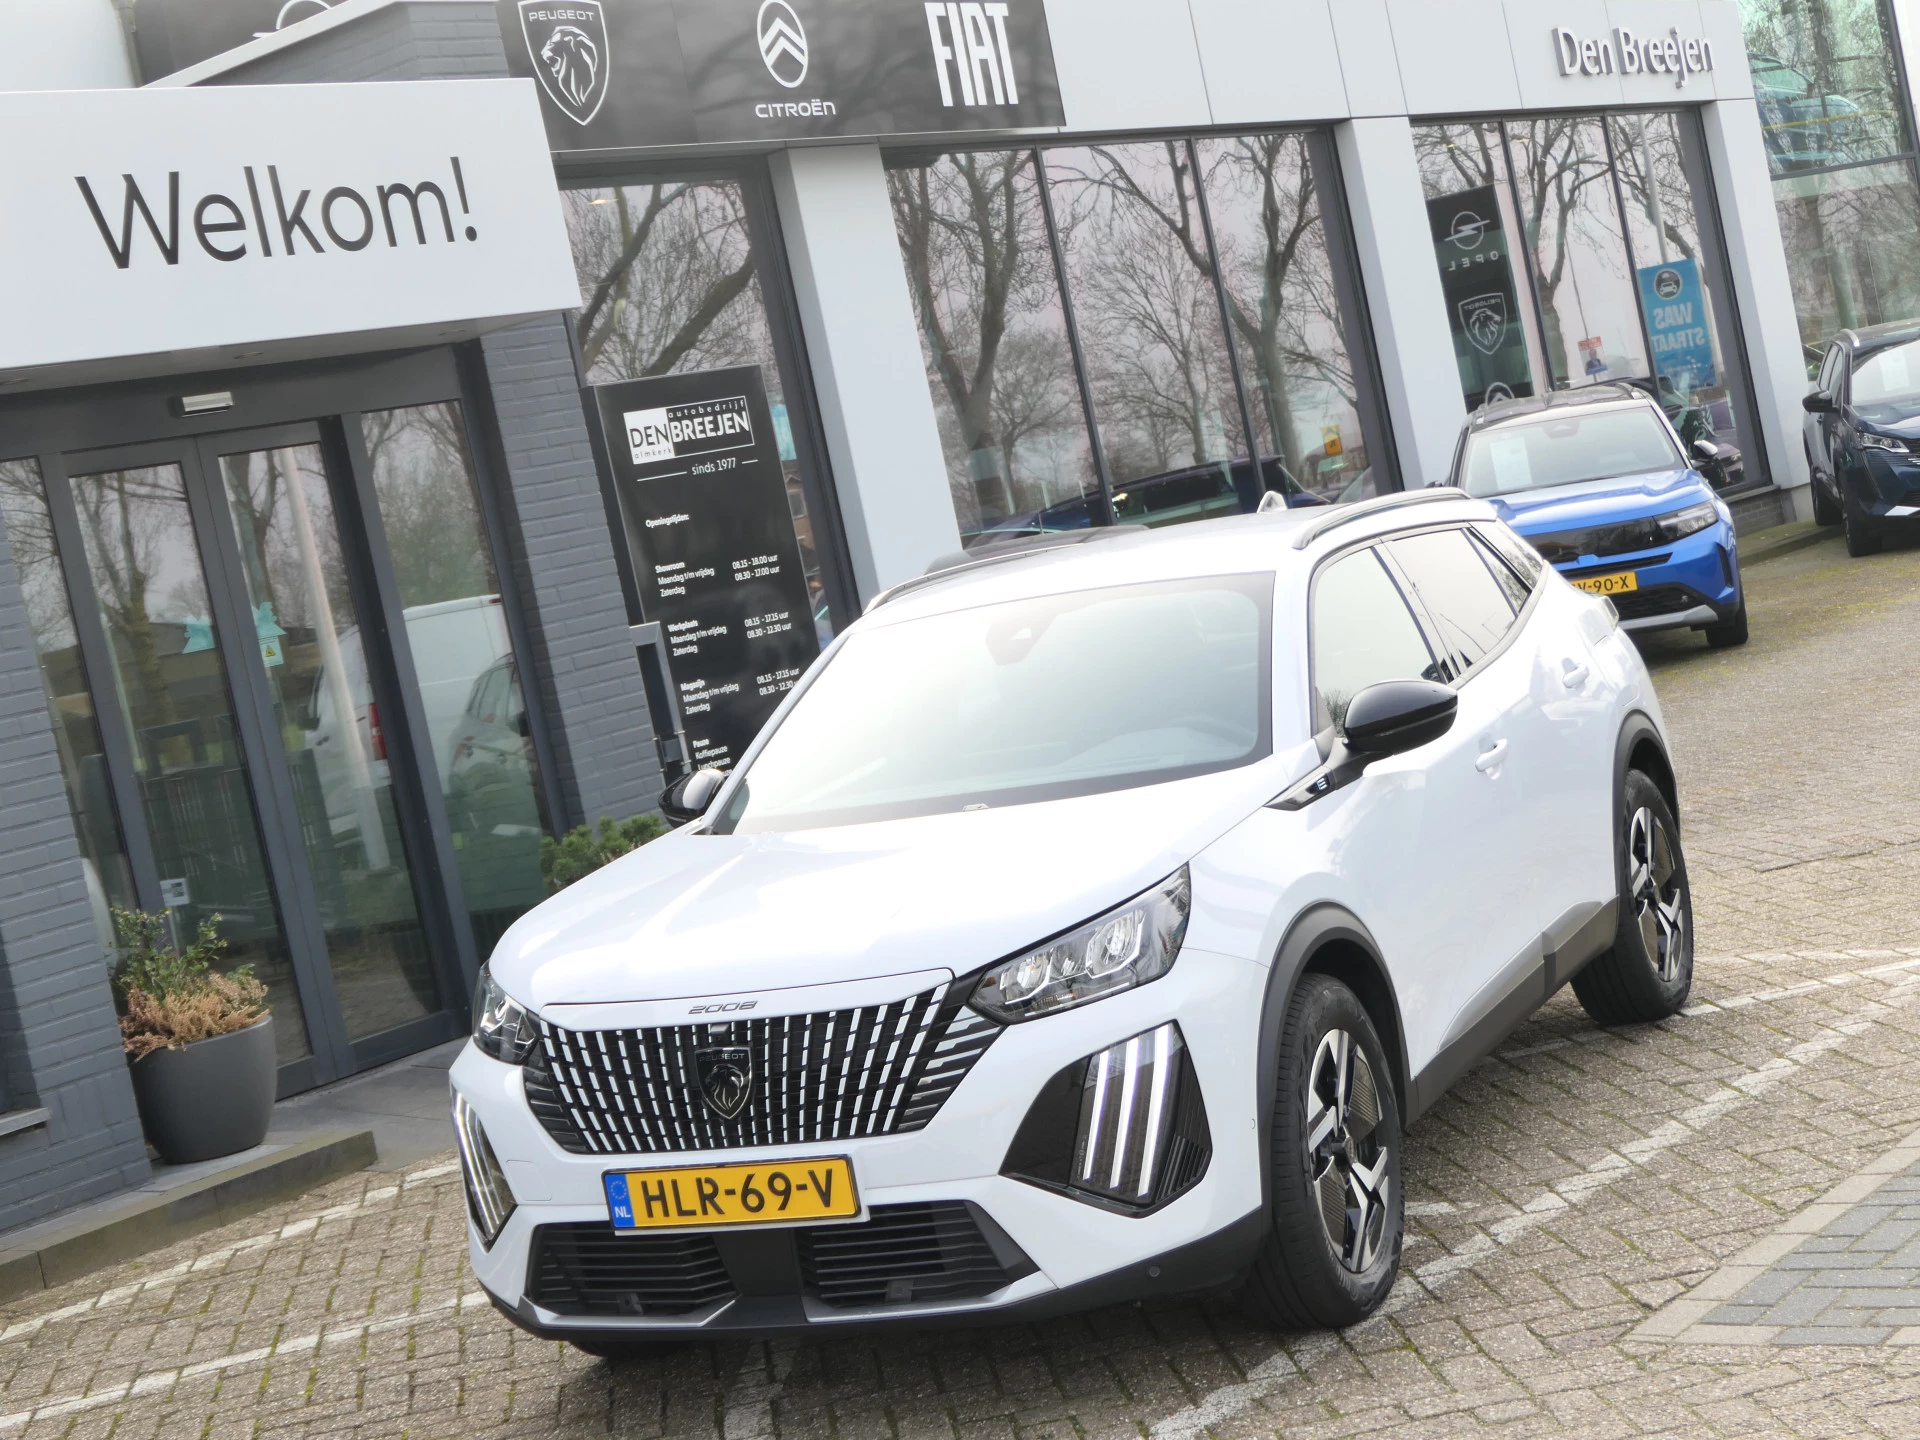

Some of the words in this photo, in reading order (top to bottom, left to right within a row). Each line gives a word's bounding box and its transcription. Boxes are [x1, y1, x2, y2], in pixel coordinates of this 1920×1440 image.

[528, 10, 594, 21] PEUGEOT
[924, 2, 1019, 107] FIAT
[1551, 26, 1615, 76] Den
[1612, 26, 1716, 89] Breejen
[755, 98, 836, 118] CITROËN
[74, 156, 479, 270] Welkom!
[668, 399, 744, 418] autobedrijf
[630, 423, 671, 448] DEN
[670, 411, 750, 443] BREEJEN
[634, 447, 672, 459] almkerk
[691, 463, 715, 475] sinds
[717, 457, 736, 471] 1977
[768, 554, 778, 562] uur
[655, 562, 685, 573] Showroom
[770, 566, 779, 574] uur
[658, 574, 684, 585] Maandag
[695, 568, 715, 578] vrijdag
[1571, 575, 1629, 593] V-90-X
[660, 586, 685, 597] Zaterdag
[670, 633, 697, 644] Maandag
[707, 626, 727, 636] vrijdag
[672, 645, 698, 656] Zaterdag
[790, 668, 799, 676] uur
[683, 691, 709, 702] Maandag
[720, 683, 739, 694] vrijdag
[685, 703, 710, 715] Zaterdag
[688, 1000, 758, 1014] 2008
[699, 1053, 745, 1061] PEUGEOT
[640, 1168, 833, 1219] HLR-69-V
[615, 1206, 631, 1218] NL
